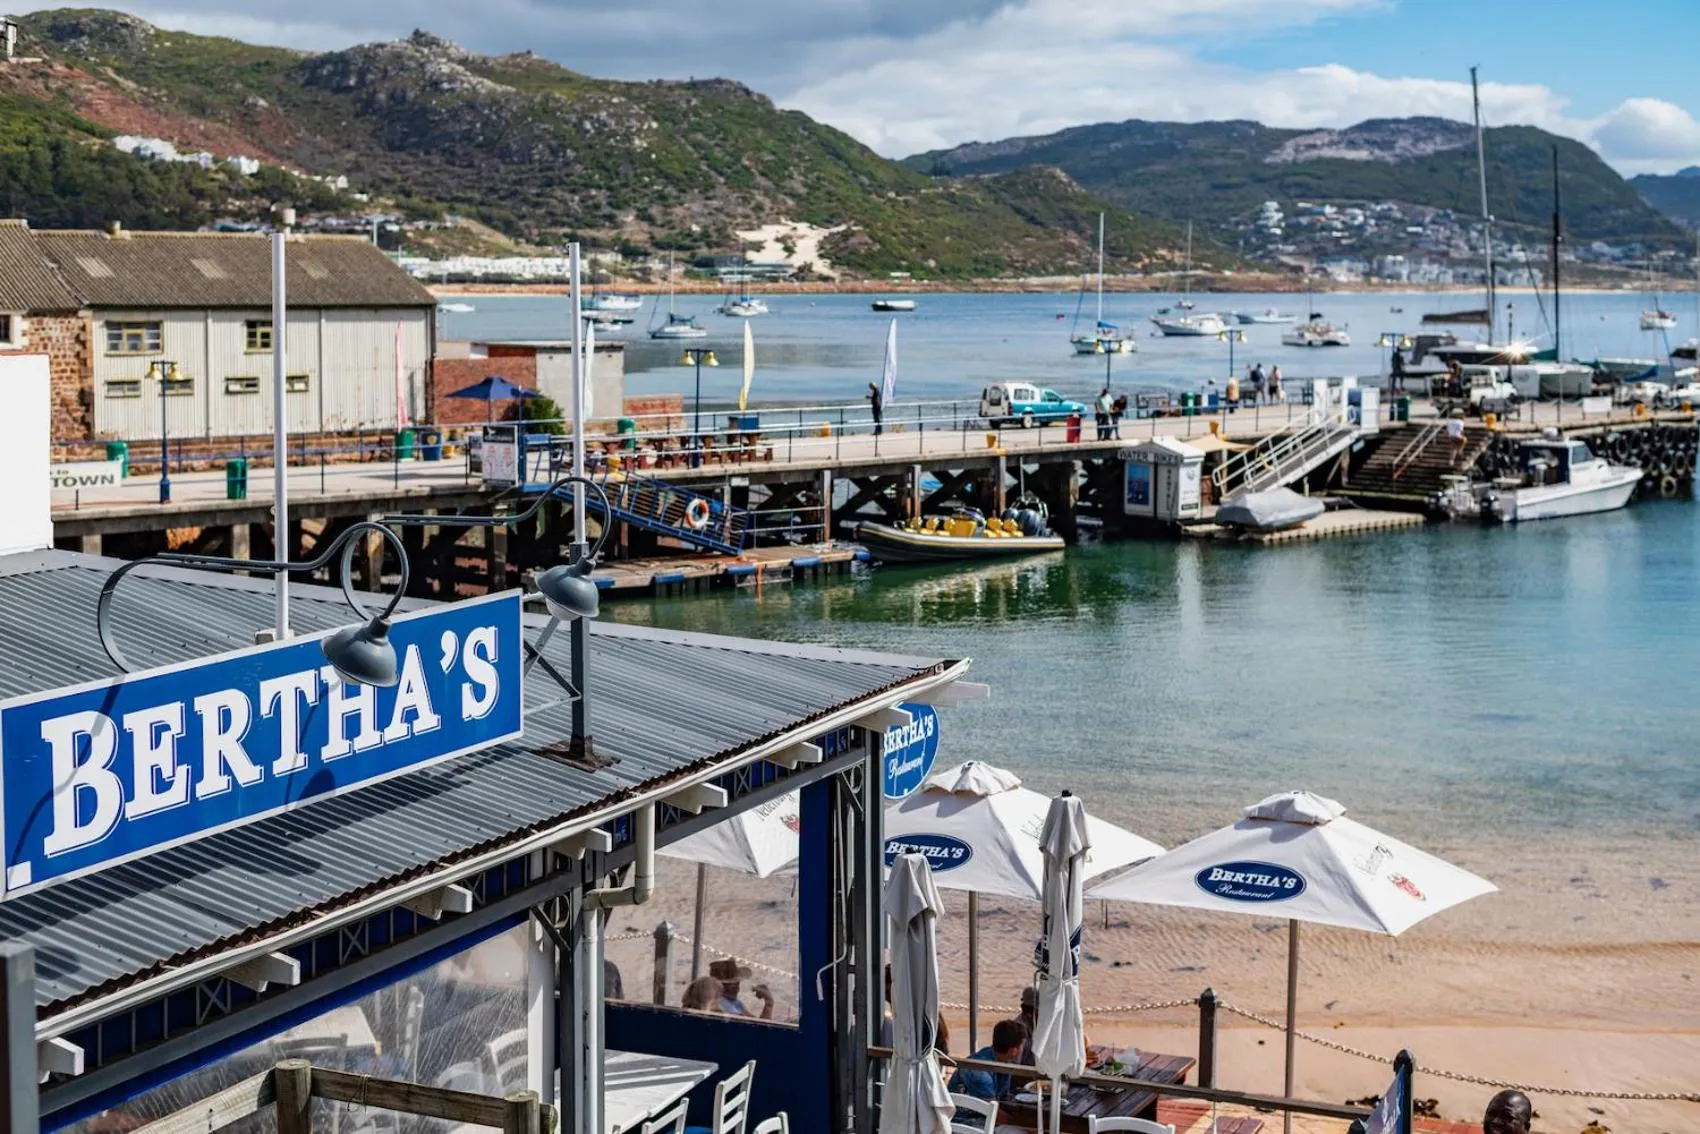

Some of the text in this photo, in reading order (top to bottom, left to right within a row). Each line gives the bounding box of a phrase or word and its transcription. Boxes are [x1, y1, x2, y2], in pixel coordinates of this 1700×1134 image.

[51, 475, 114, 488] TOWN
[40, 625, 500, 858] BERTHA'S
[1208, 867, 1298, 889] BERTHA'S
[1215, 882, 1275, 899] Restaurant
